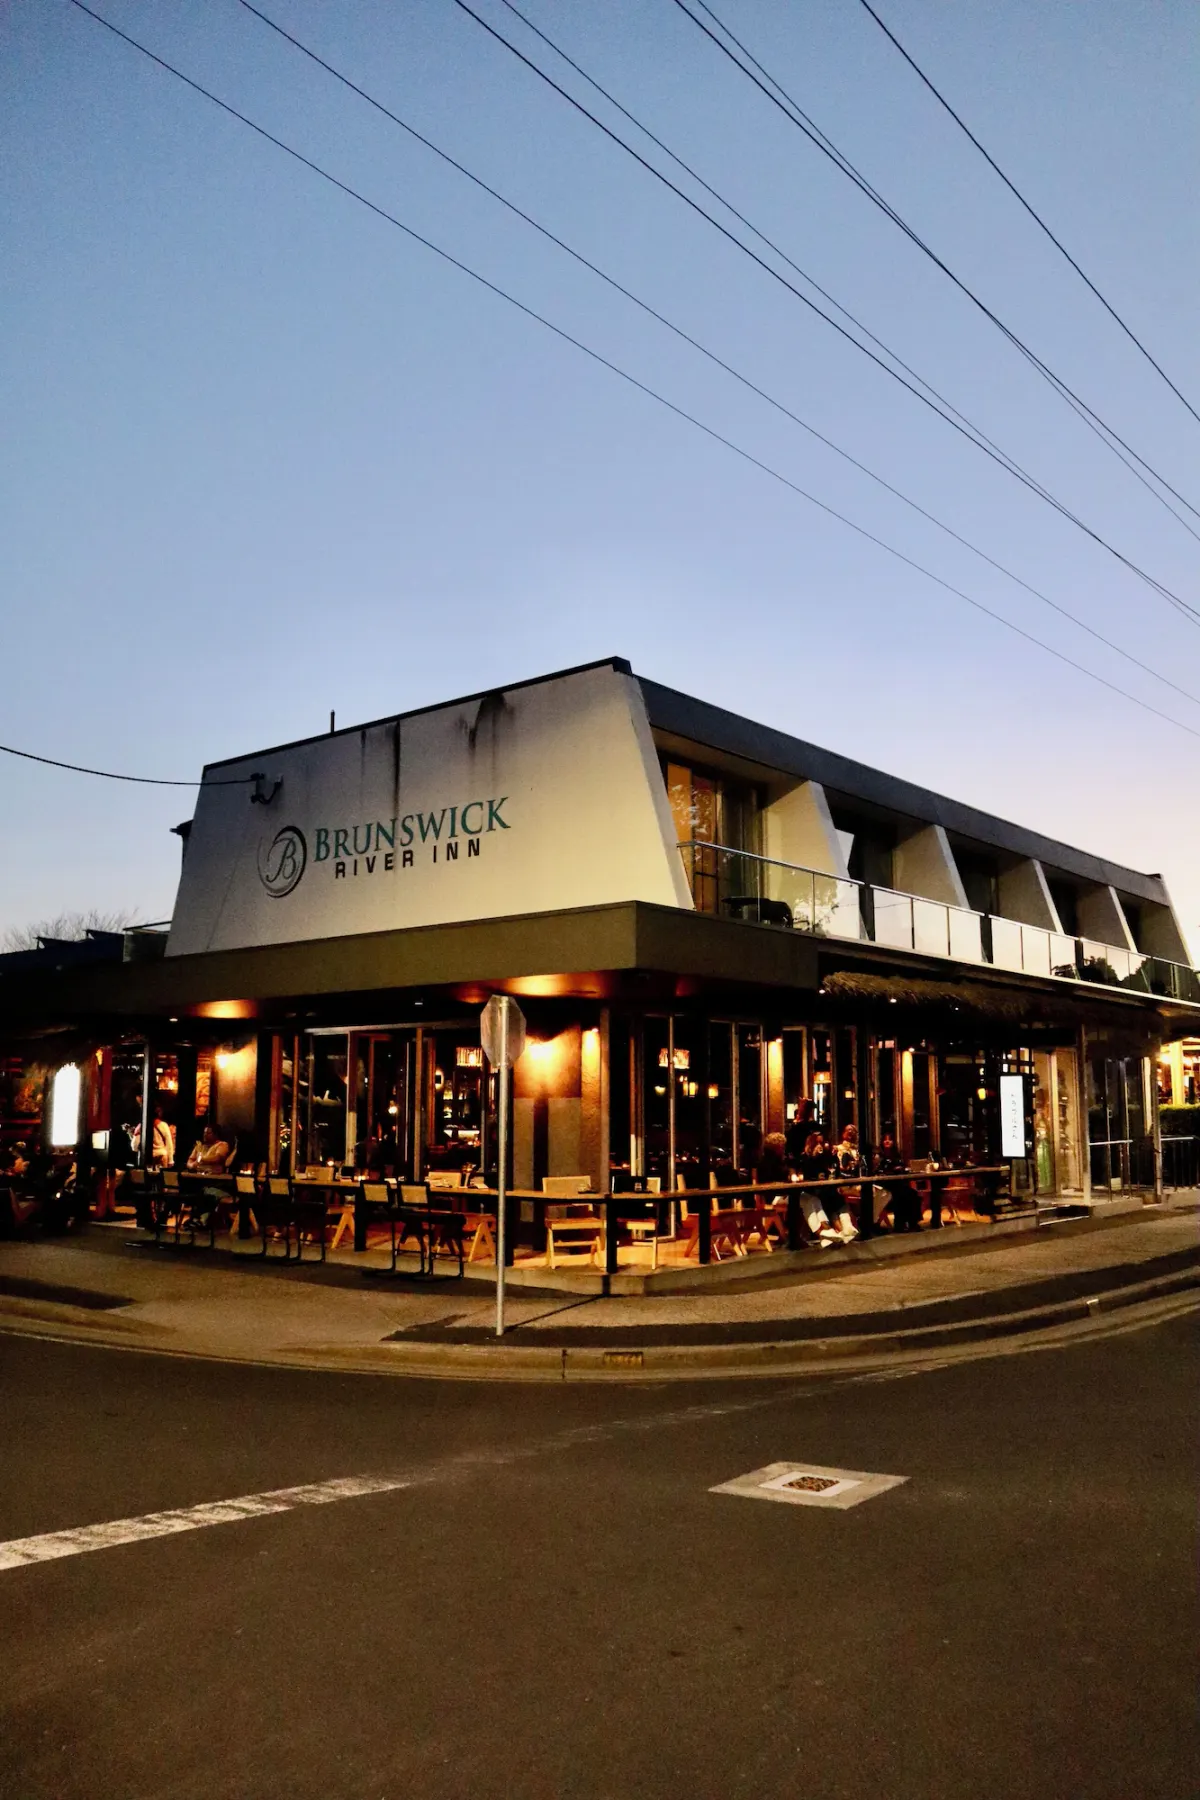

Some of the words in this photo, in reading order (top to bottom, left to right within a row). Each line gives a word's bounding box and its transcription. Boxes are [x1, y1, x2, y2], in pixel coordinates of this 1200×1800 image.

[314, 796, 511, 863] BRUNSWICK
[335, 849, 414, 879] RIVER
[433, 838, 480, 864] INN
